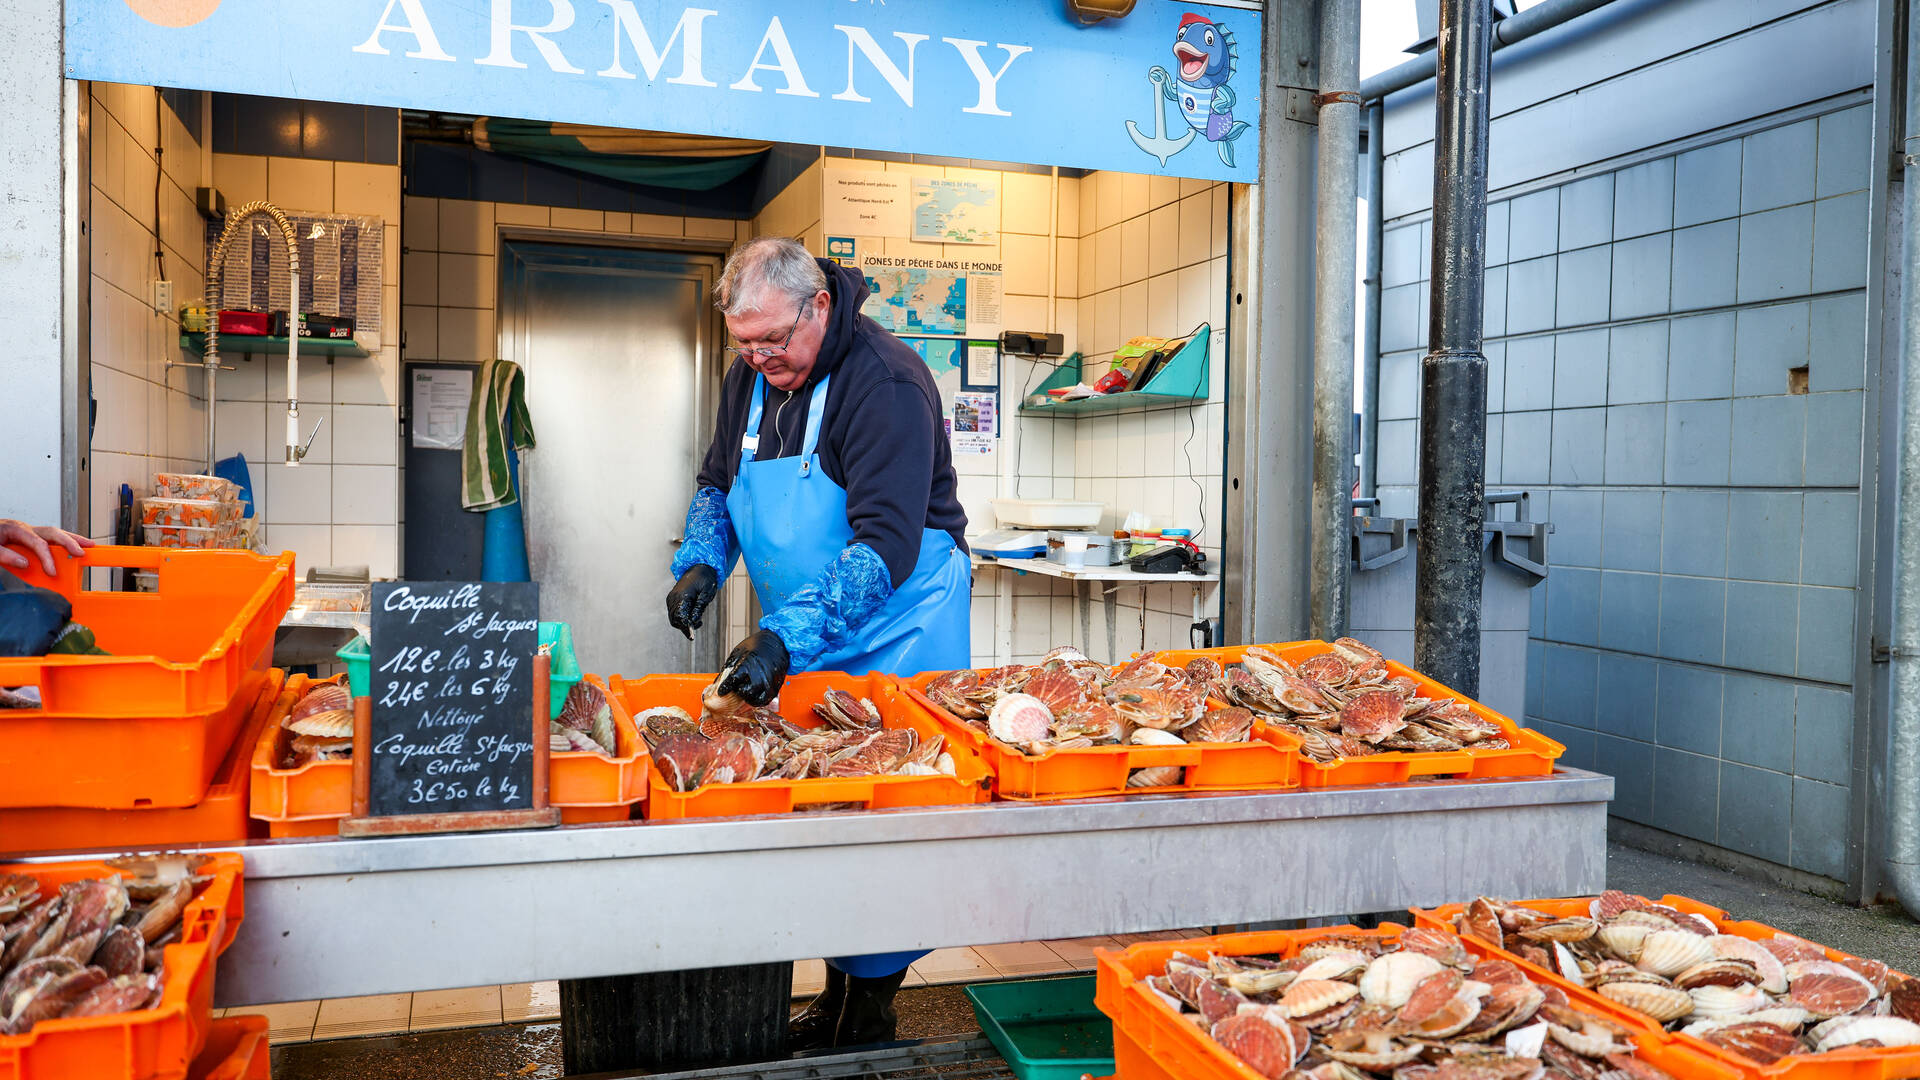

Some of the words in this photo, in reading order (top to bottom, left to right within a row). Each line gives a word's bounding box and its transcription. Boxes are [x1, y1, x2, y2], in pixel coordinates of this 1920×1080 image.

[352, 0, 1033, 117] ARMANY
[864, 257, 892, 266] ZONES
[895, 258, 906, 267] DE
[936, 261, 959, 270] DANS
[961, 262, 970, 270] LE
[972, 263, 1003, 272] MONDE
[384, 584, 482, 624] Coquille
[444, 611, 483, 636] St
[472, 611, 538, 643] Jacques
[379, 646, 441, 674] 12€
[440, 645, 471, 672] les
[479, 650, 494, 669] 3
[497, 648, 519, 681] kg
[379, 681, 429, 708] 24€
[434, 675, 463, 698] les
[471, 678, 490, 695] 6
[373, 733, 464, 766] Coquille
[474, 736, 497, 755] St
[488, 734, 534, 764] Jacqu
[475, 776, 492, 797] le
[499, 776, 521, 804] kg
